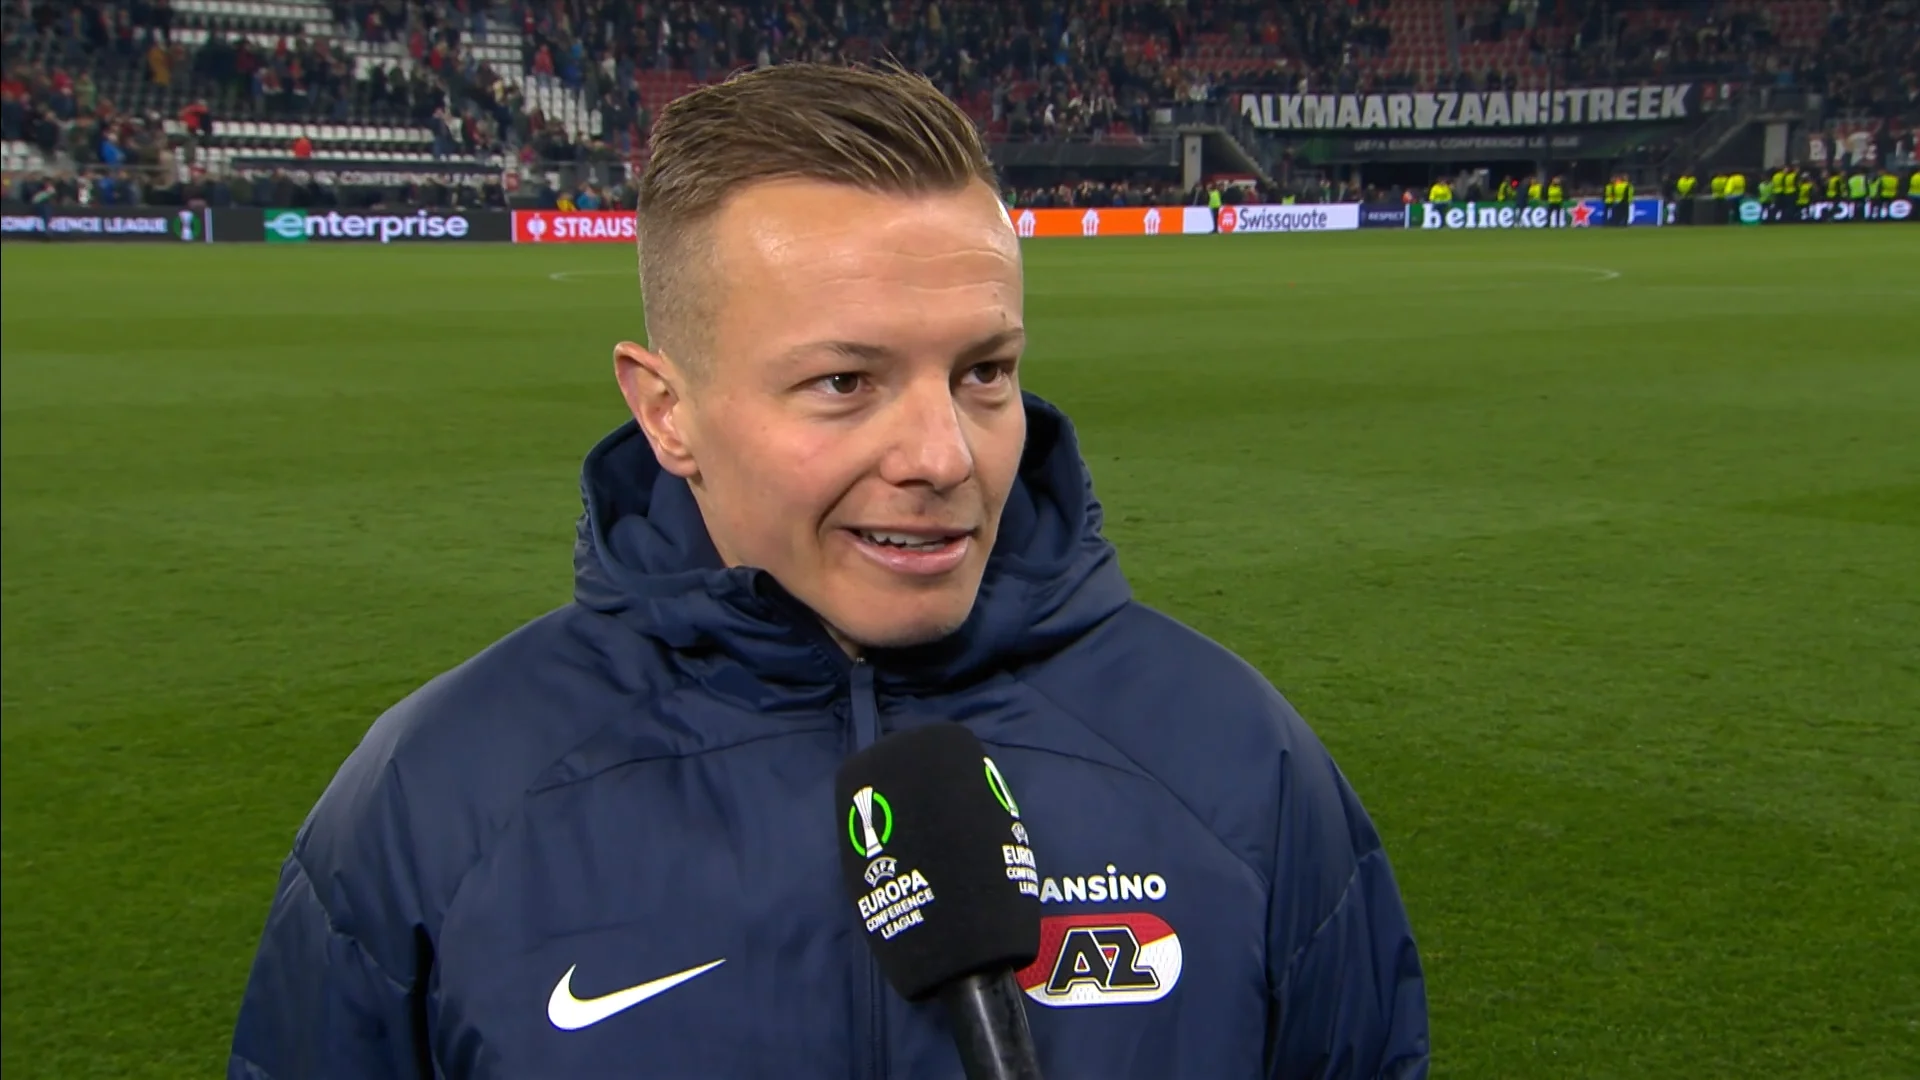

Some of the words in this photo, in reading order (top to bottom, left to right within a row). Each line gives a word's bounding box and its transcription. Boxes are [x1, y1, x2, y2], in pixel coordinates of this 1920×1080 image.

[1240, 93, 1411, 129] ALKMAAR
[1437, 83, 1692, 127] ZAANSTREEK
[1388, 138, 1437, 151] EUROPA
[1440, 135, 1525, 150] CONFERENCE
[1528, 135, 1580, 149] LEGUE
[103, 216, 167, 232] LEAGUE
[264, 209, 469, 243] enterprise
[553, 216, 638, 237] STRAUS
[1238, 207, 1327, 231] Swissquote
[1367, 211, 1404, 221] RESPECT
[1002, 844, 1036, 869] EURO
[857, 868, 929, 920] EUROPA
[1040, 864, 1166, 903] ANSiNO
[866, 887, 935, 933] CONFERENCE
[881, 909, 924, 939] LEAGUE
[1046, 926, 1160, 994] AZ
